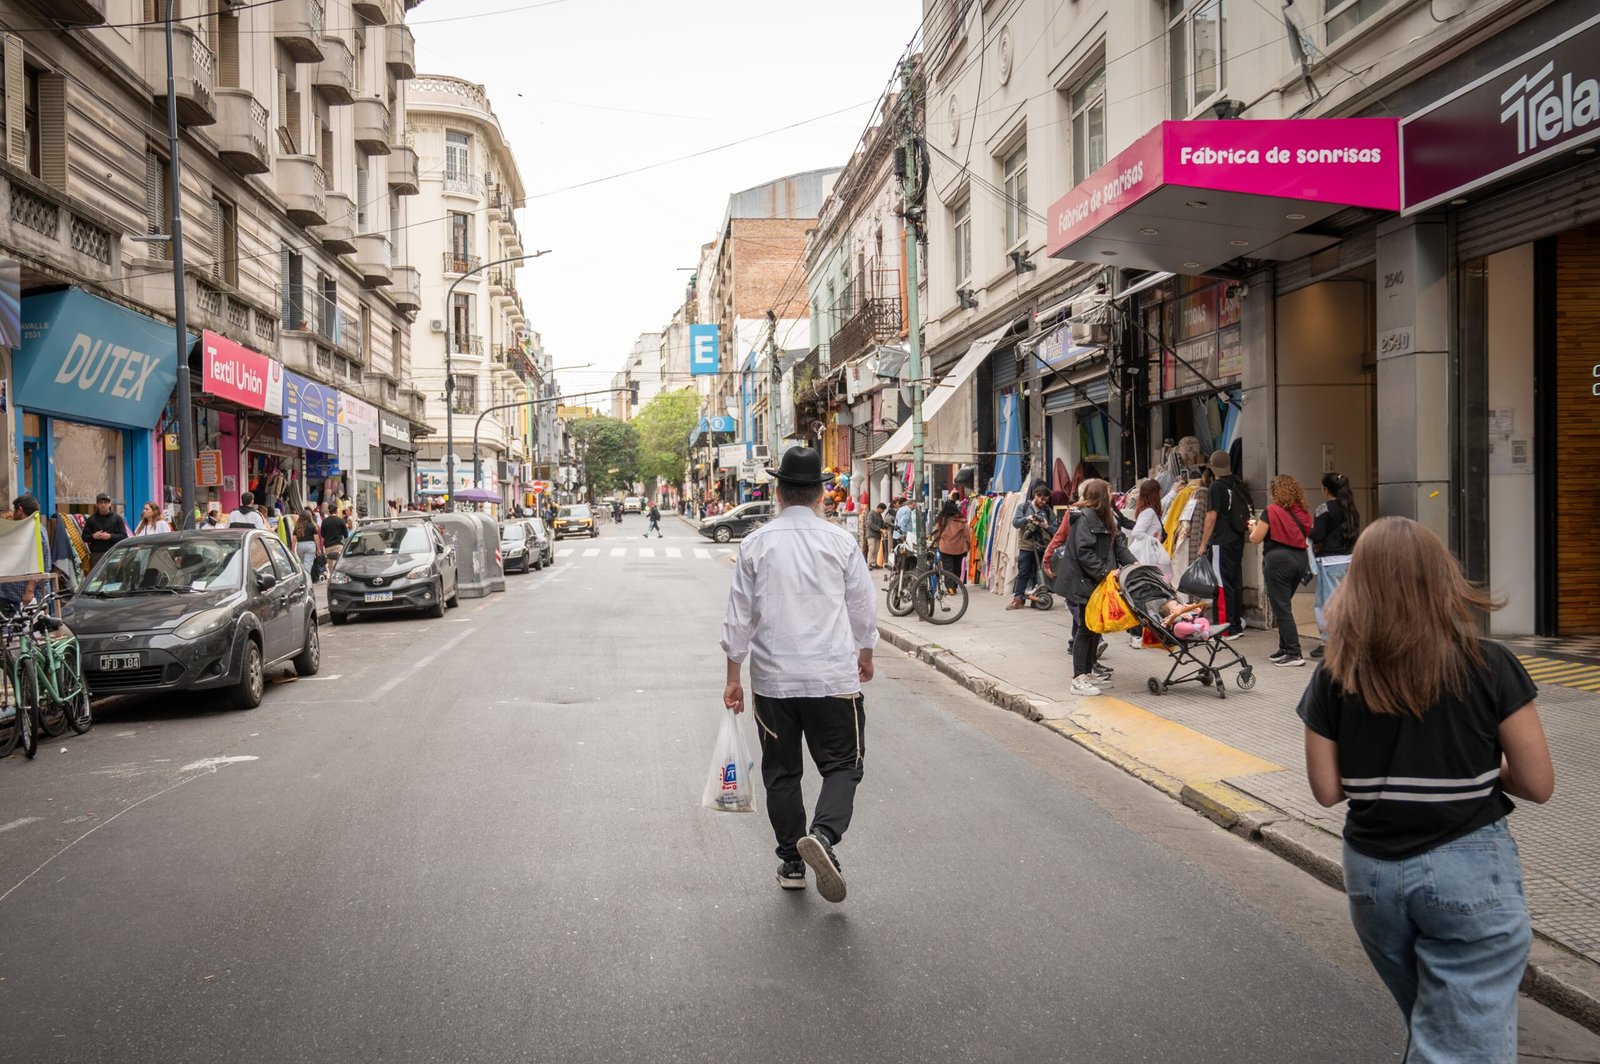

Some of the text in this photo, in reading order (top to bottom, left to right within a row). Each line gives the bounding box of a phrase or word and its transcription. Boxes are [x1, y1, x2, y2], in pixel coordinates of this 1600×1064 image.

[1500, 59, 1600, 155] Tela
[1180, 146, 1382, 165] Fábrica de sonrisas
[1058, 160, 1143, 234] Fábrica de sonrisas
[20, 321, 49, 330] AVALLE
[1381, 332, 1410, 354] 2540
[54, 332, 161, 402] DUTEX
[694, 335, 714, 364] E
[207, 346, 235, 386] Textil
[235, 361, 263, 396] Unión
